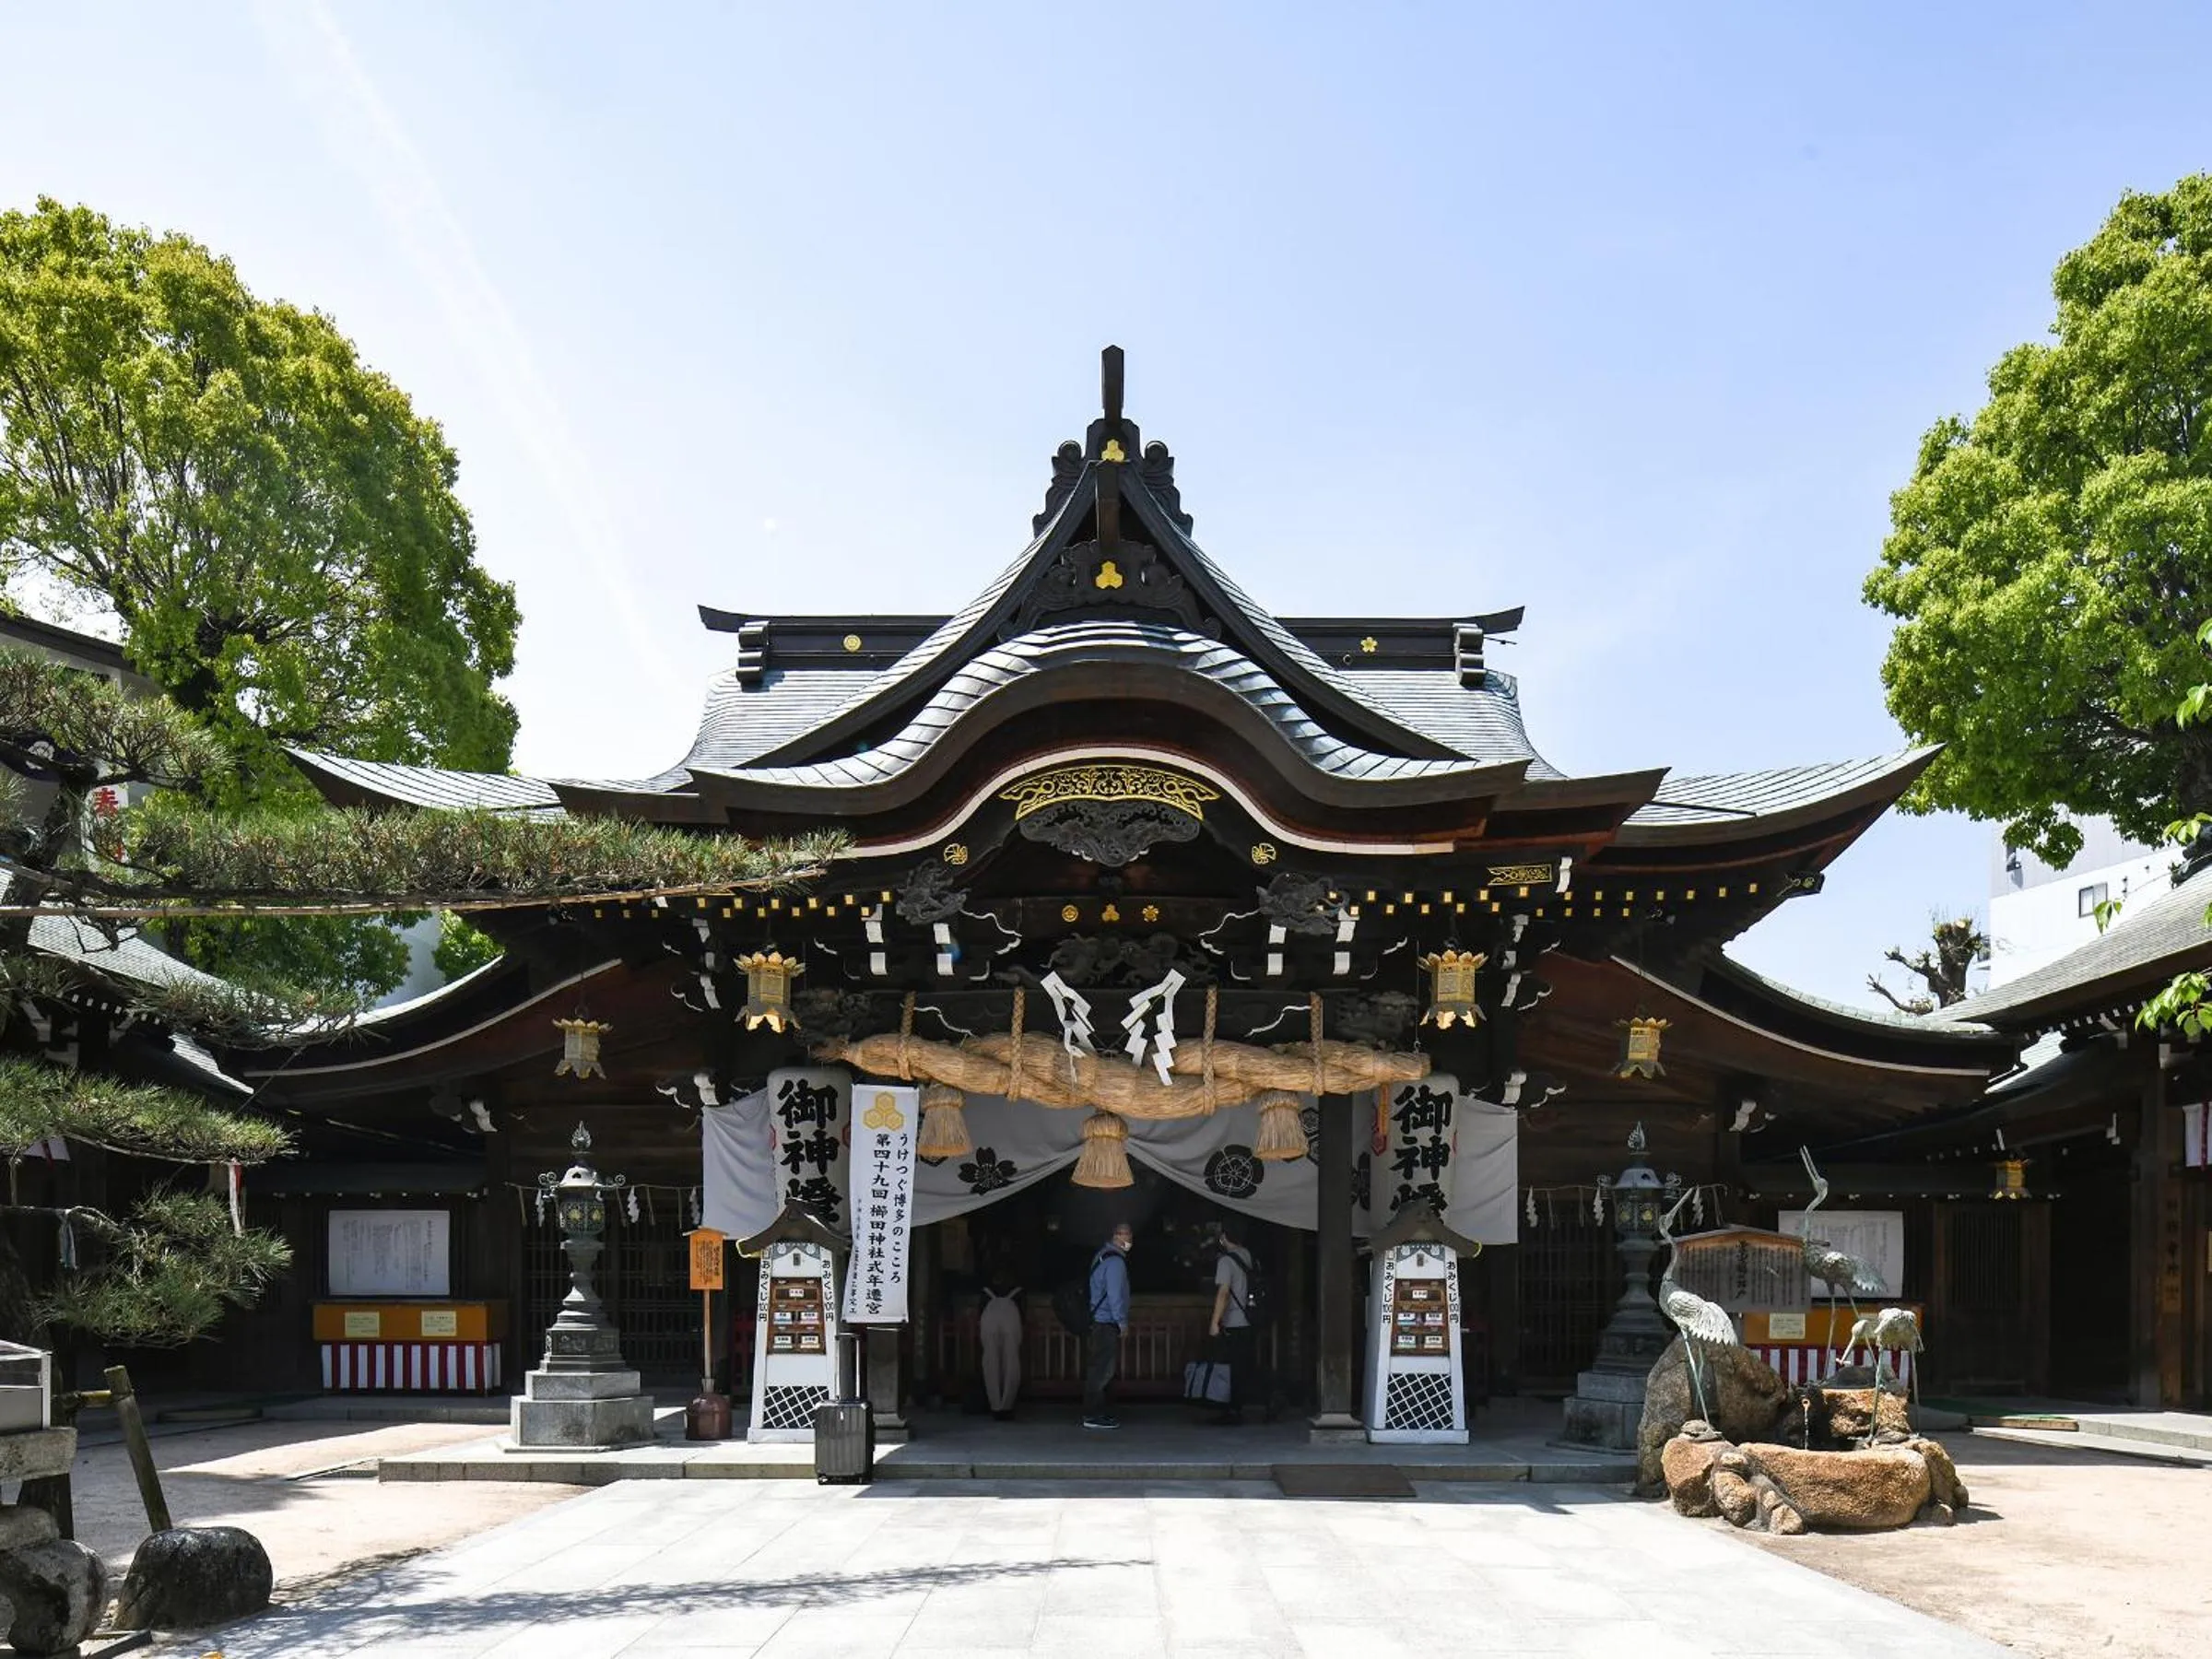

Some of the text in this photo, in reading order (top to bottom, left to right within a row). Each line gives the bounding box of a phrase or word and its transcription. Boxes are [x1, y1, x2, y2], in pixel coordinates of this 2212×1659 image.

[890, 1133, 909, 1284] うけつぐ博多のこころ
